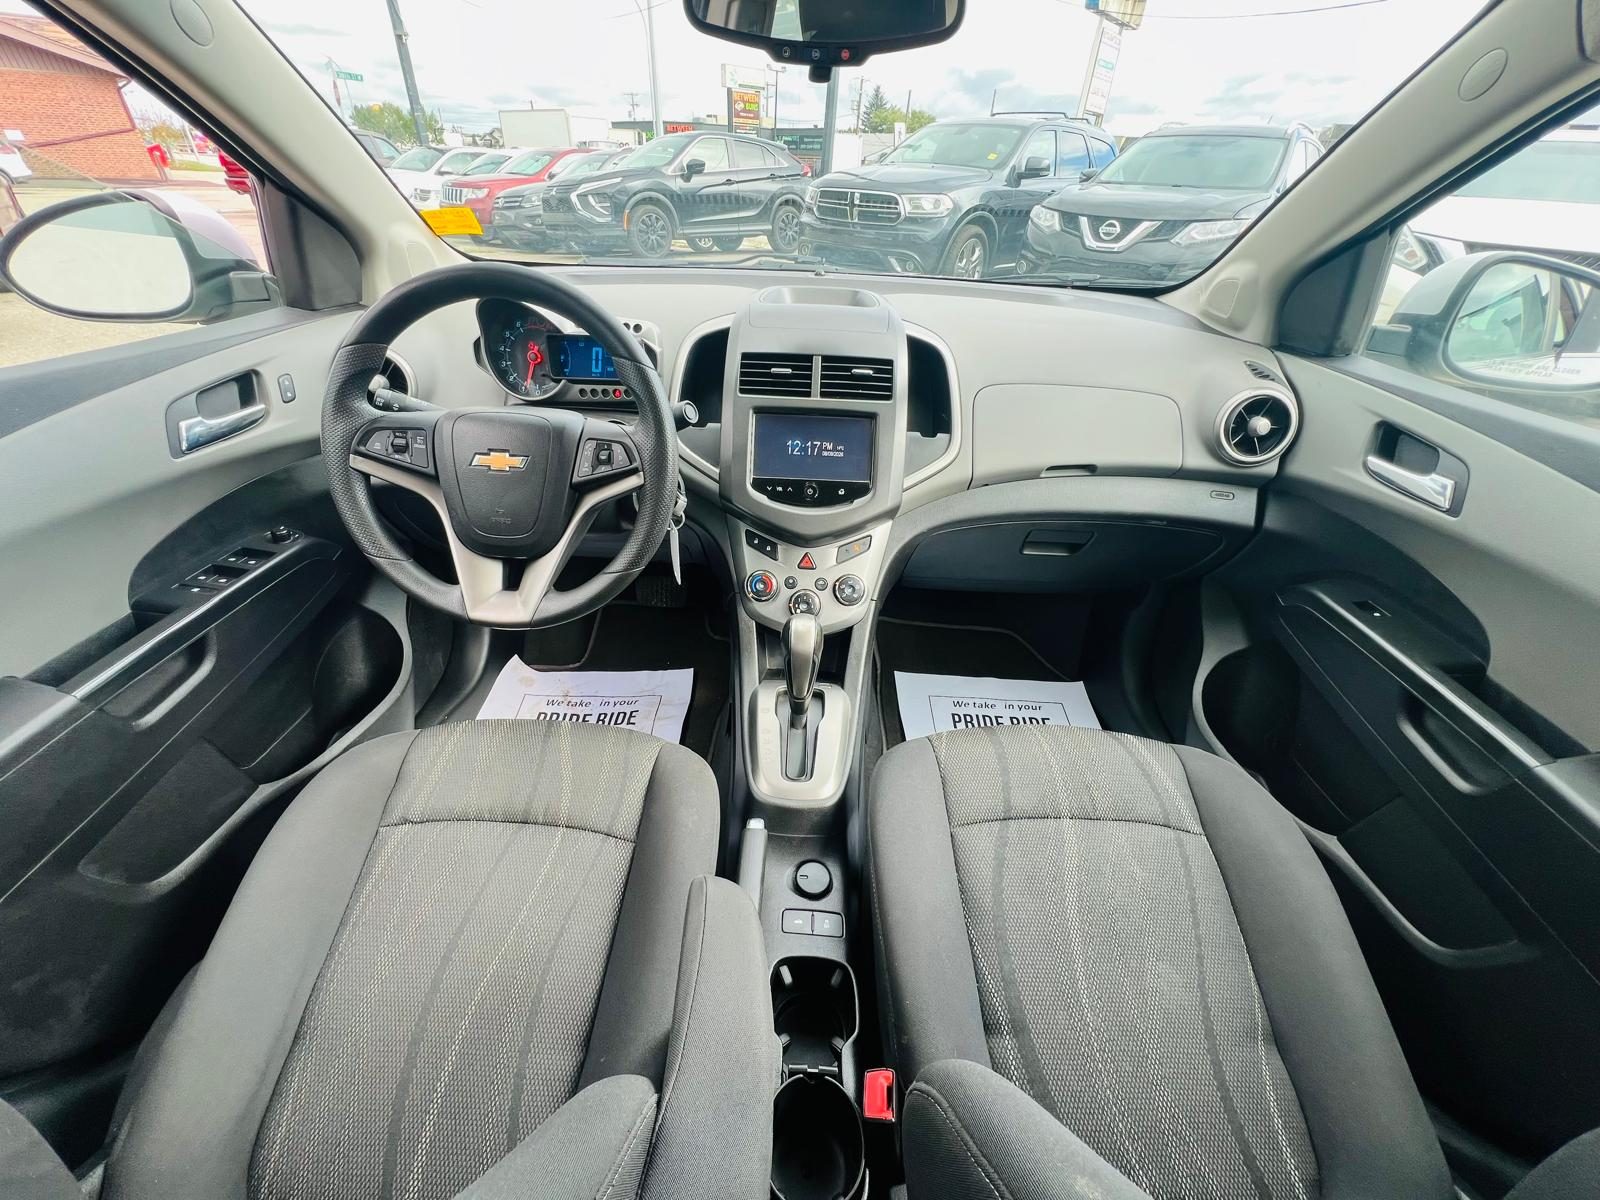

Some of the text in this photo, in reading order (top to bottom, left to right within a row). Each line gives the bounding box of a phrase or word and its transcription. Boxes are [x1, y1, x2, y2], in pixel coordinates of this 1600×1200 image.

[735, 92, 759, 103] BETWEEN
[592, 347, 602, 373] 0
[787, 440, 820, 455] 12:17
[823, 442, 833, 450] PM
[566, 699, 592, 707] take
[599, 699, 610, 707] in
[612, 699, 639, 708] your
[973, 701, 997, 709] take
[1004, 702, 1014, 710] in
[596, 710, 640, 726] RIDE
[951, 713, 1004, 729] PRIDE
